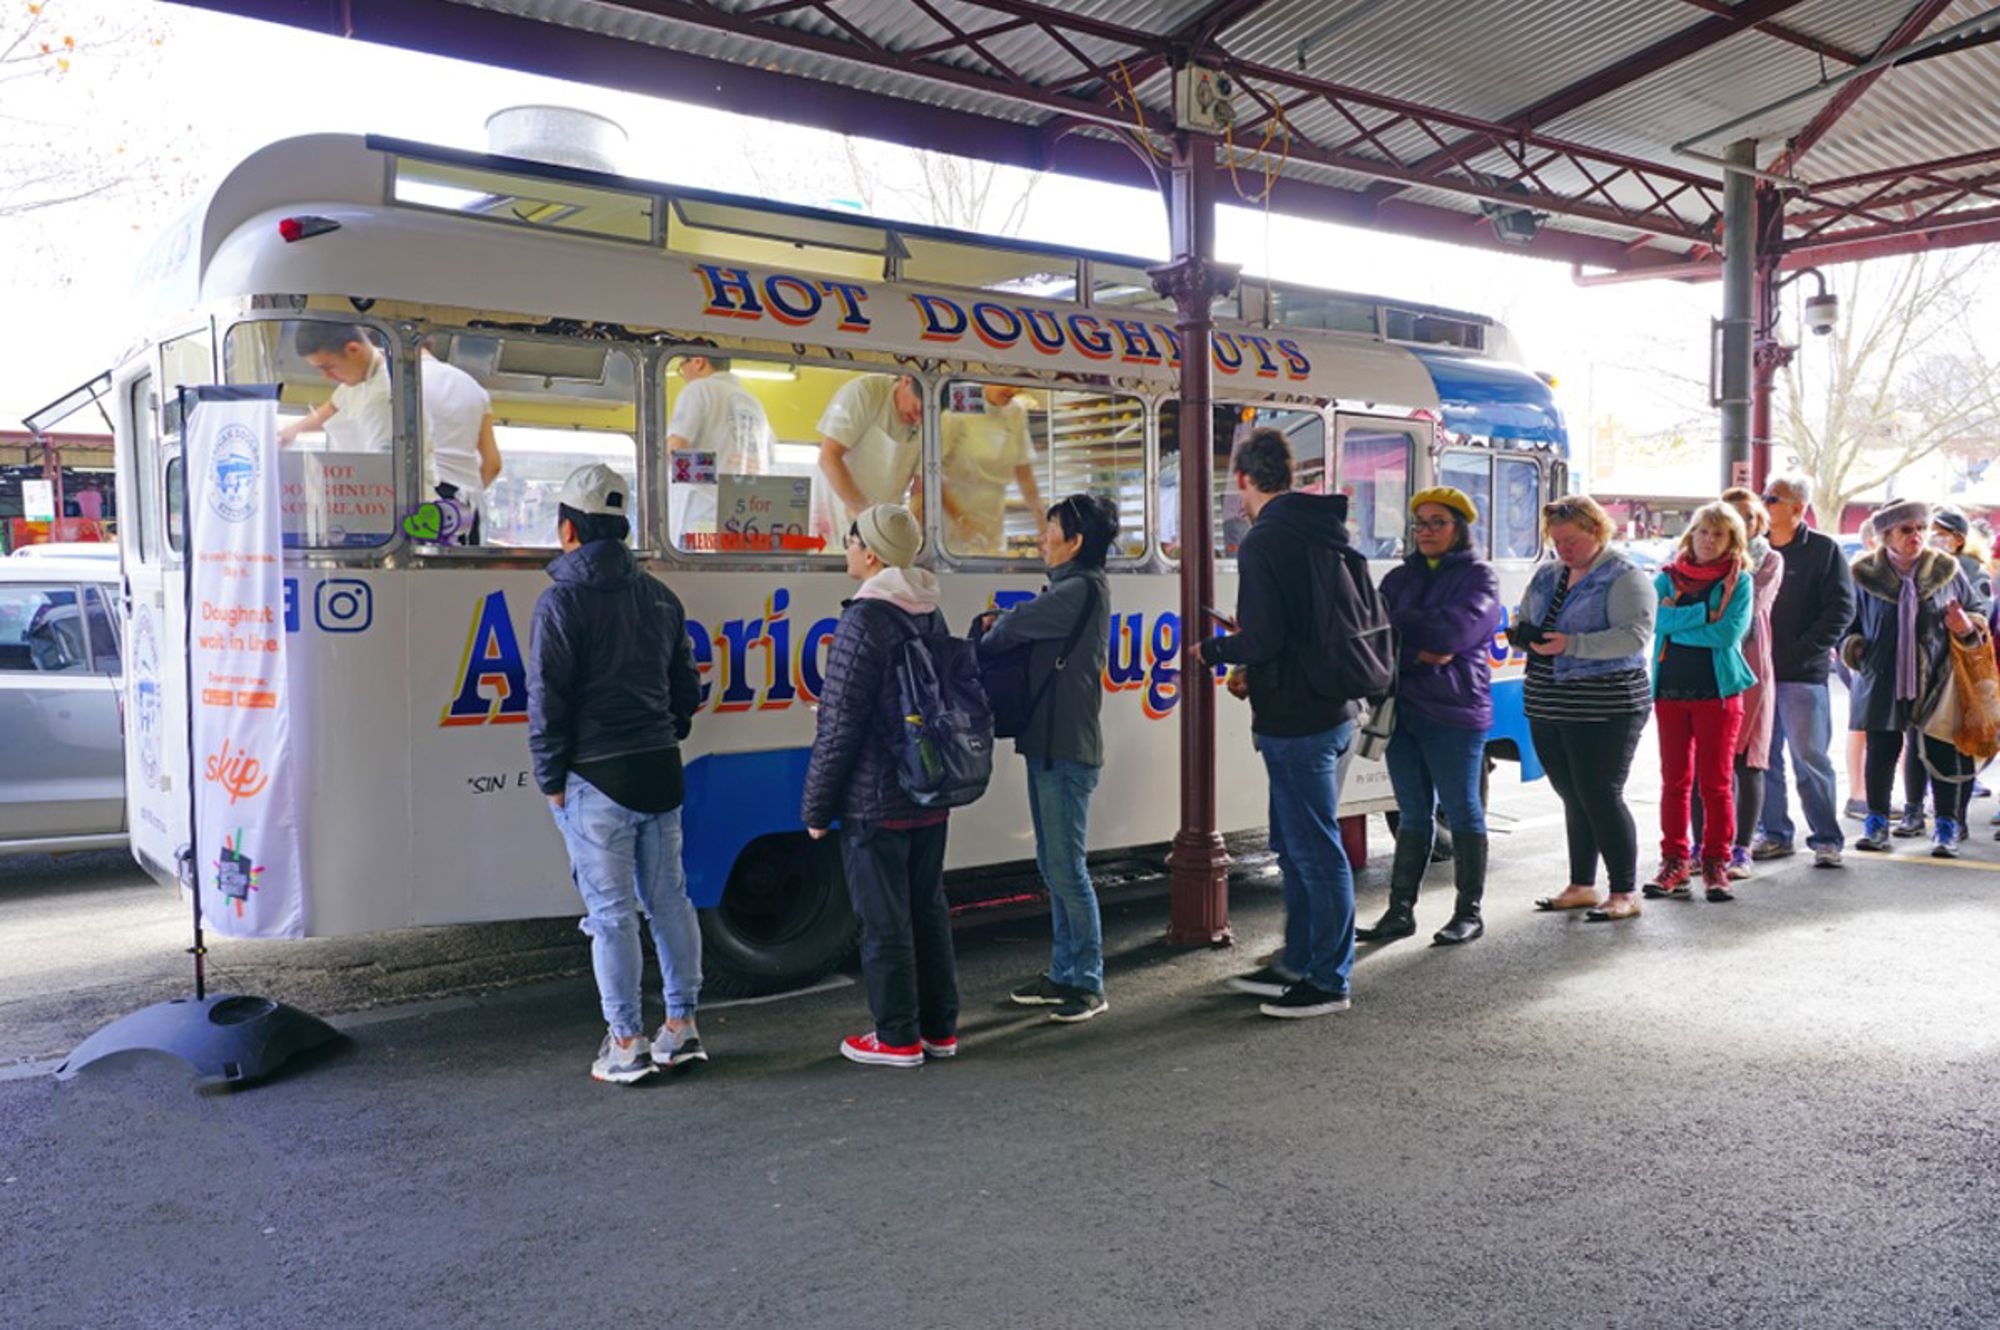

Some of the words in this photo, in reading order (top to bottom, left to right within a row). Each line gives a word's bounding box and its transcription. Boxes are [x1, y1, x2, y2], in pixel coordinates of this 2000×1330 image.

[693, 264, 871, 333] HOT
[735, 498, 746, 514] 5
[748, 495, 772, 513] for
[201, 600, 273, 628] Doughnut
[198, 631, 225, 649] wait
[230, 631, 245, 651] in
[205, 738, 268, 806] skip
